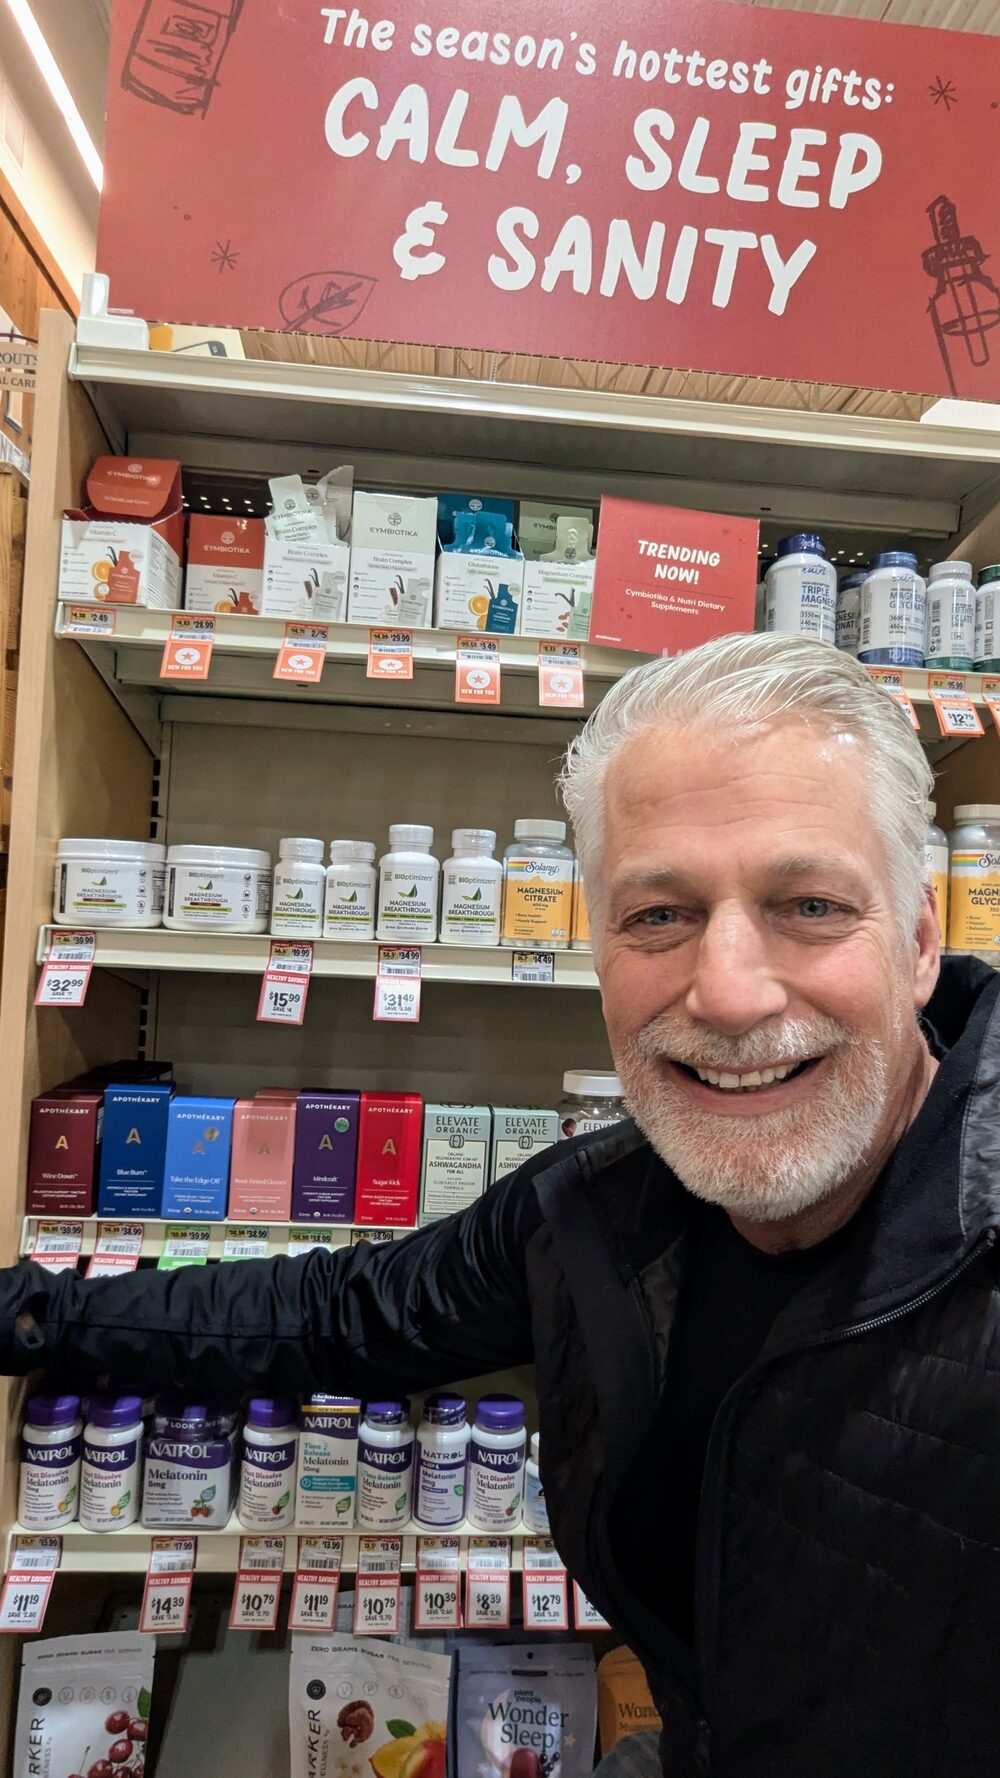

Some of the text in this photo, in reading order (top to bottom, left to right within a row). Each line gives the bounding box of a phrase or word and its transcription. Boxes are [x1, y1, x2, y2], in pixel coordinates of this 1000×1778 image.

[320, 8, 895, 110] The season's hottest gifts:
[324, 76, 884, 212] CALM, SLEEP
[393, 201, 818, 318] & SANITY
[369, 526, 420, 538] CYMBIOTIKA
[638, 540, 721, 567] TRENDING
[655, 563, 699, 585] NOW!
[802, 585, 830, 597] TRIPLE
[625, 588, 668, 602] Cymbiotika
[677, 597, 697, 607] Nutri
[698, 600, 725, 612] Dietary
[651, 601, 699, 615] Supplements
[525, 860, 560, 876] Solaray
[517, 887, 564, 896] MAGNESIUM
[968, 888, 1000, 897] MAGN
[524, 895, 558, 903] CITRATE
[384, 906, 432, 914] BREAKTHROUGH
[454, 903, 490, 911] MAGNESIUM
[448, 909, 495, 917] BREAKTHROUGH
[113, 1095, 160, 1103] APOTHÉKARY
[39, 1106, 90, 1114] APOTHÉKARY
[177, 1113, 226, 1121] APOTHÉKARY
[436, 1116, 479, 1127] ELEVATE
[505, 1117, 548, 1128] ELEVATE
[55, 1135, 70, 1150] A
[429, 1161, 482, 1170] ASHWAGANDHA
[195, 1177, 209, 1186] Edge
[171, 1422, 195, 1430] LOOK
[305, 1416, 355, 1428] NATROL
[27, 1445, 74, 1462] NATROL
[85, 1447, 128, 1463] NATROL
[150, 1444, 212, 1458] NATROL
[245, 1447, 288, 1463] NATROL
[424, 1450, 464, 1459] NATROL
[303, 1456, 349, 1466] Melatonin
[364, 1450, 407, 1464] NATROL
[478, 1450, 520, 1464] NATROL
[40, 1469, 69, 1478] Dissolve
[148, 1468, 208, 1480] Melatonin
[255, 1472, 282, 1480] Dissolve
[364, 1470, 376, 1478] Time
[422, 1470, 456, 1480] Melatonin
[477, 1470, 516, 1481] Fast Dissolve
[26, 1476, 68, 1487] Melatonin
[84, 1478, 122, 1488] Melatonin
[148, 1481, 166, 1490] 5mg
[244, 1476, 282, 1488] Melatonin
[362, 1478, 402, 1488] Melatonin
[476, 1478, 516, 1489] Melatonin
[174, 1542, 192, 1550] $17.99
[264, 1540, 282, 1548] $13.49
[322, 1540, 340, 1550] $13.99
[381, 1543, 400, 1551] $13.49
[440, 1540, 458, 1548] $12.99
[361, 1648, 384, 1659] SUGAR
[516, 1695, 542, 1704] people
[488, 1702, 570, 1728] Wonder
[500, 1723, 555, 1751] Sleep
